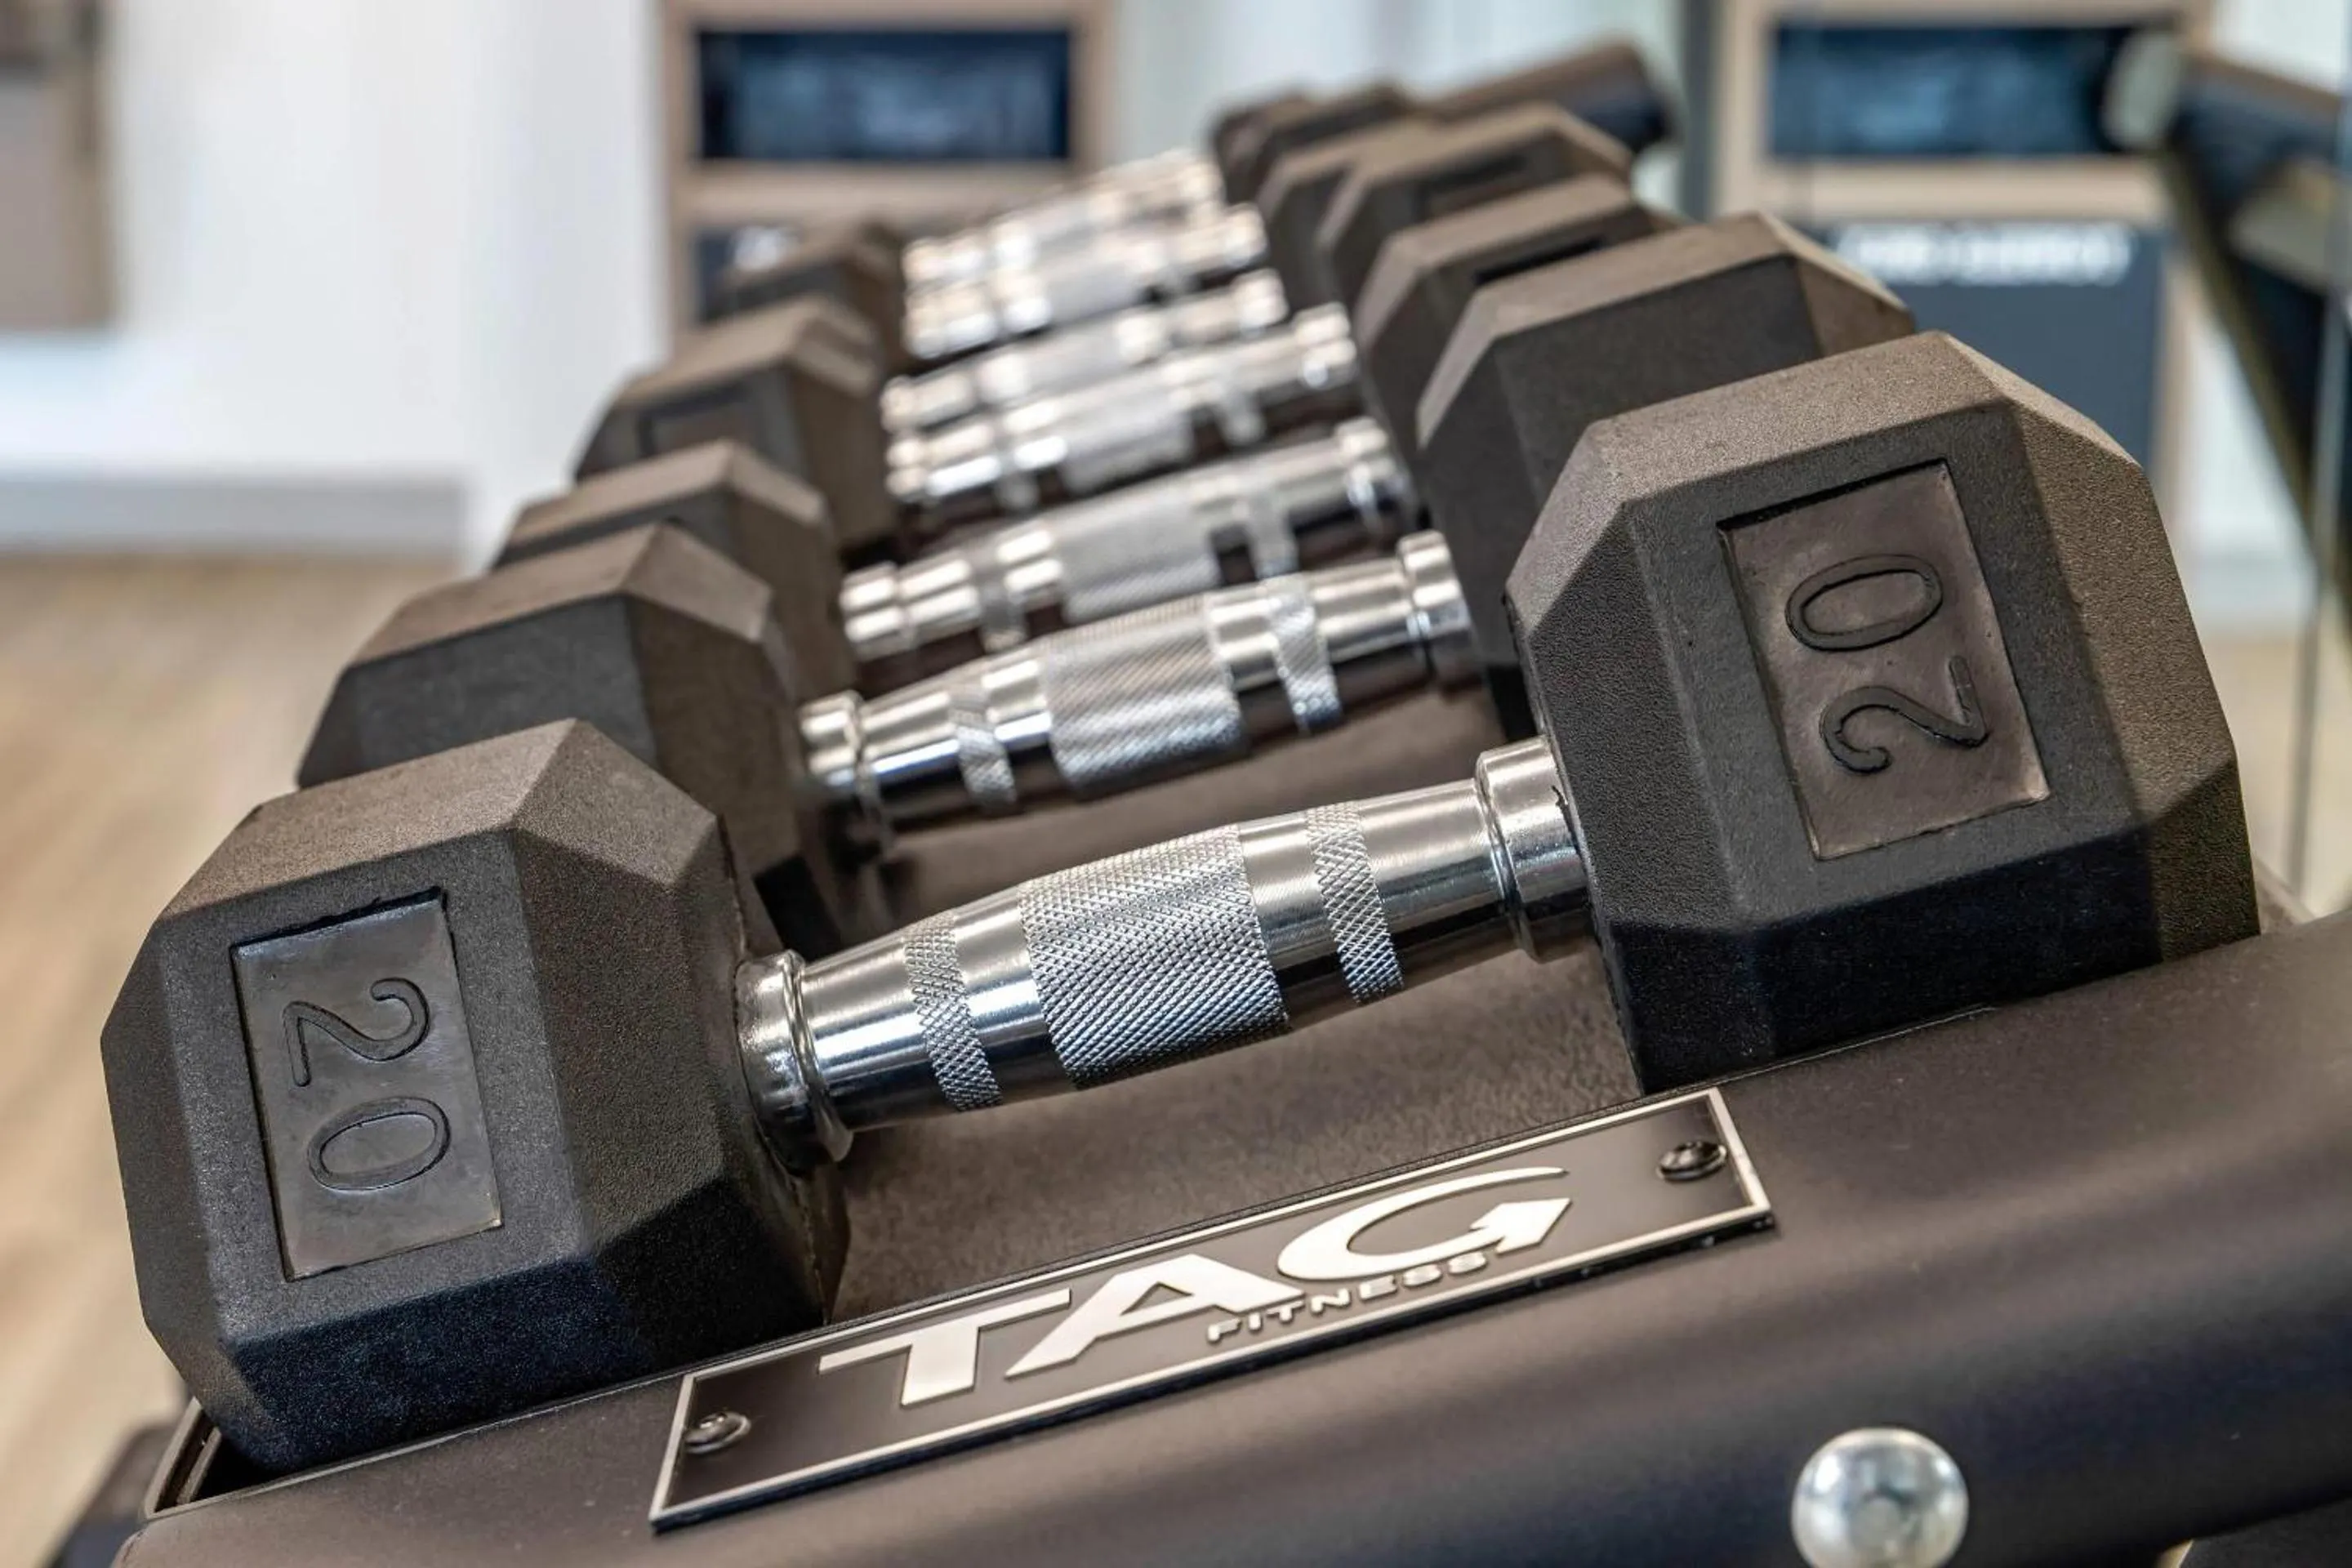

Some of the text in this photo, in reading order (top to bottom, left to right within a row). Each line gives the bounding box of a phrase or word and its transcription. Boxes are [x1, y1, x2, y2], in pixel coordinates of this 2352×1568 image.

[1785, 554, 1990, 776] 20
[282, 977, 451, 1192] 20
[817, 1166, 1572, 1405] TAG
[1207, 1251, 1487, 1342] FITNESS
